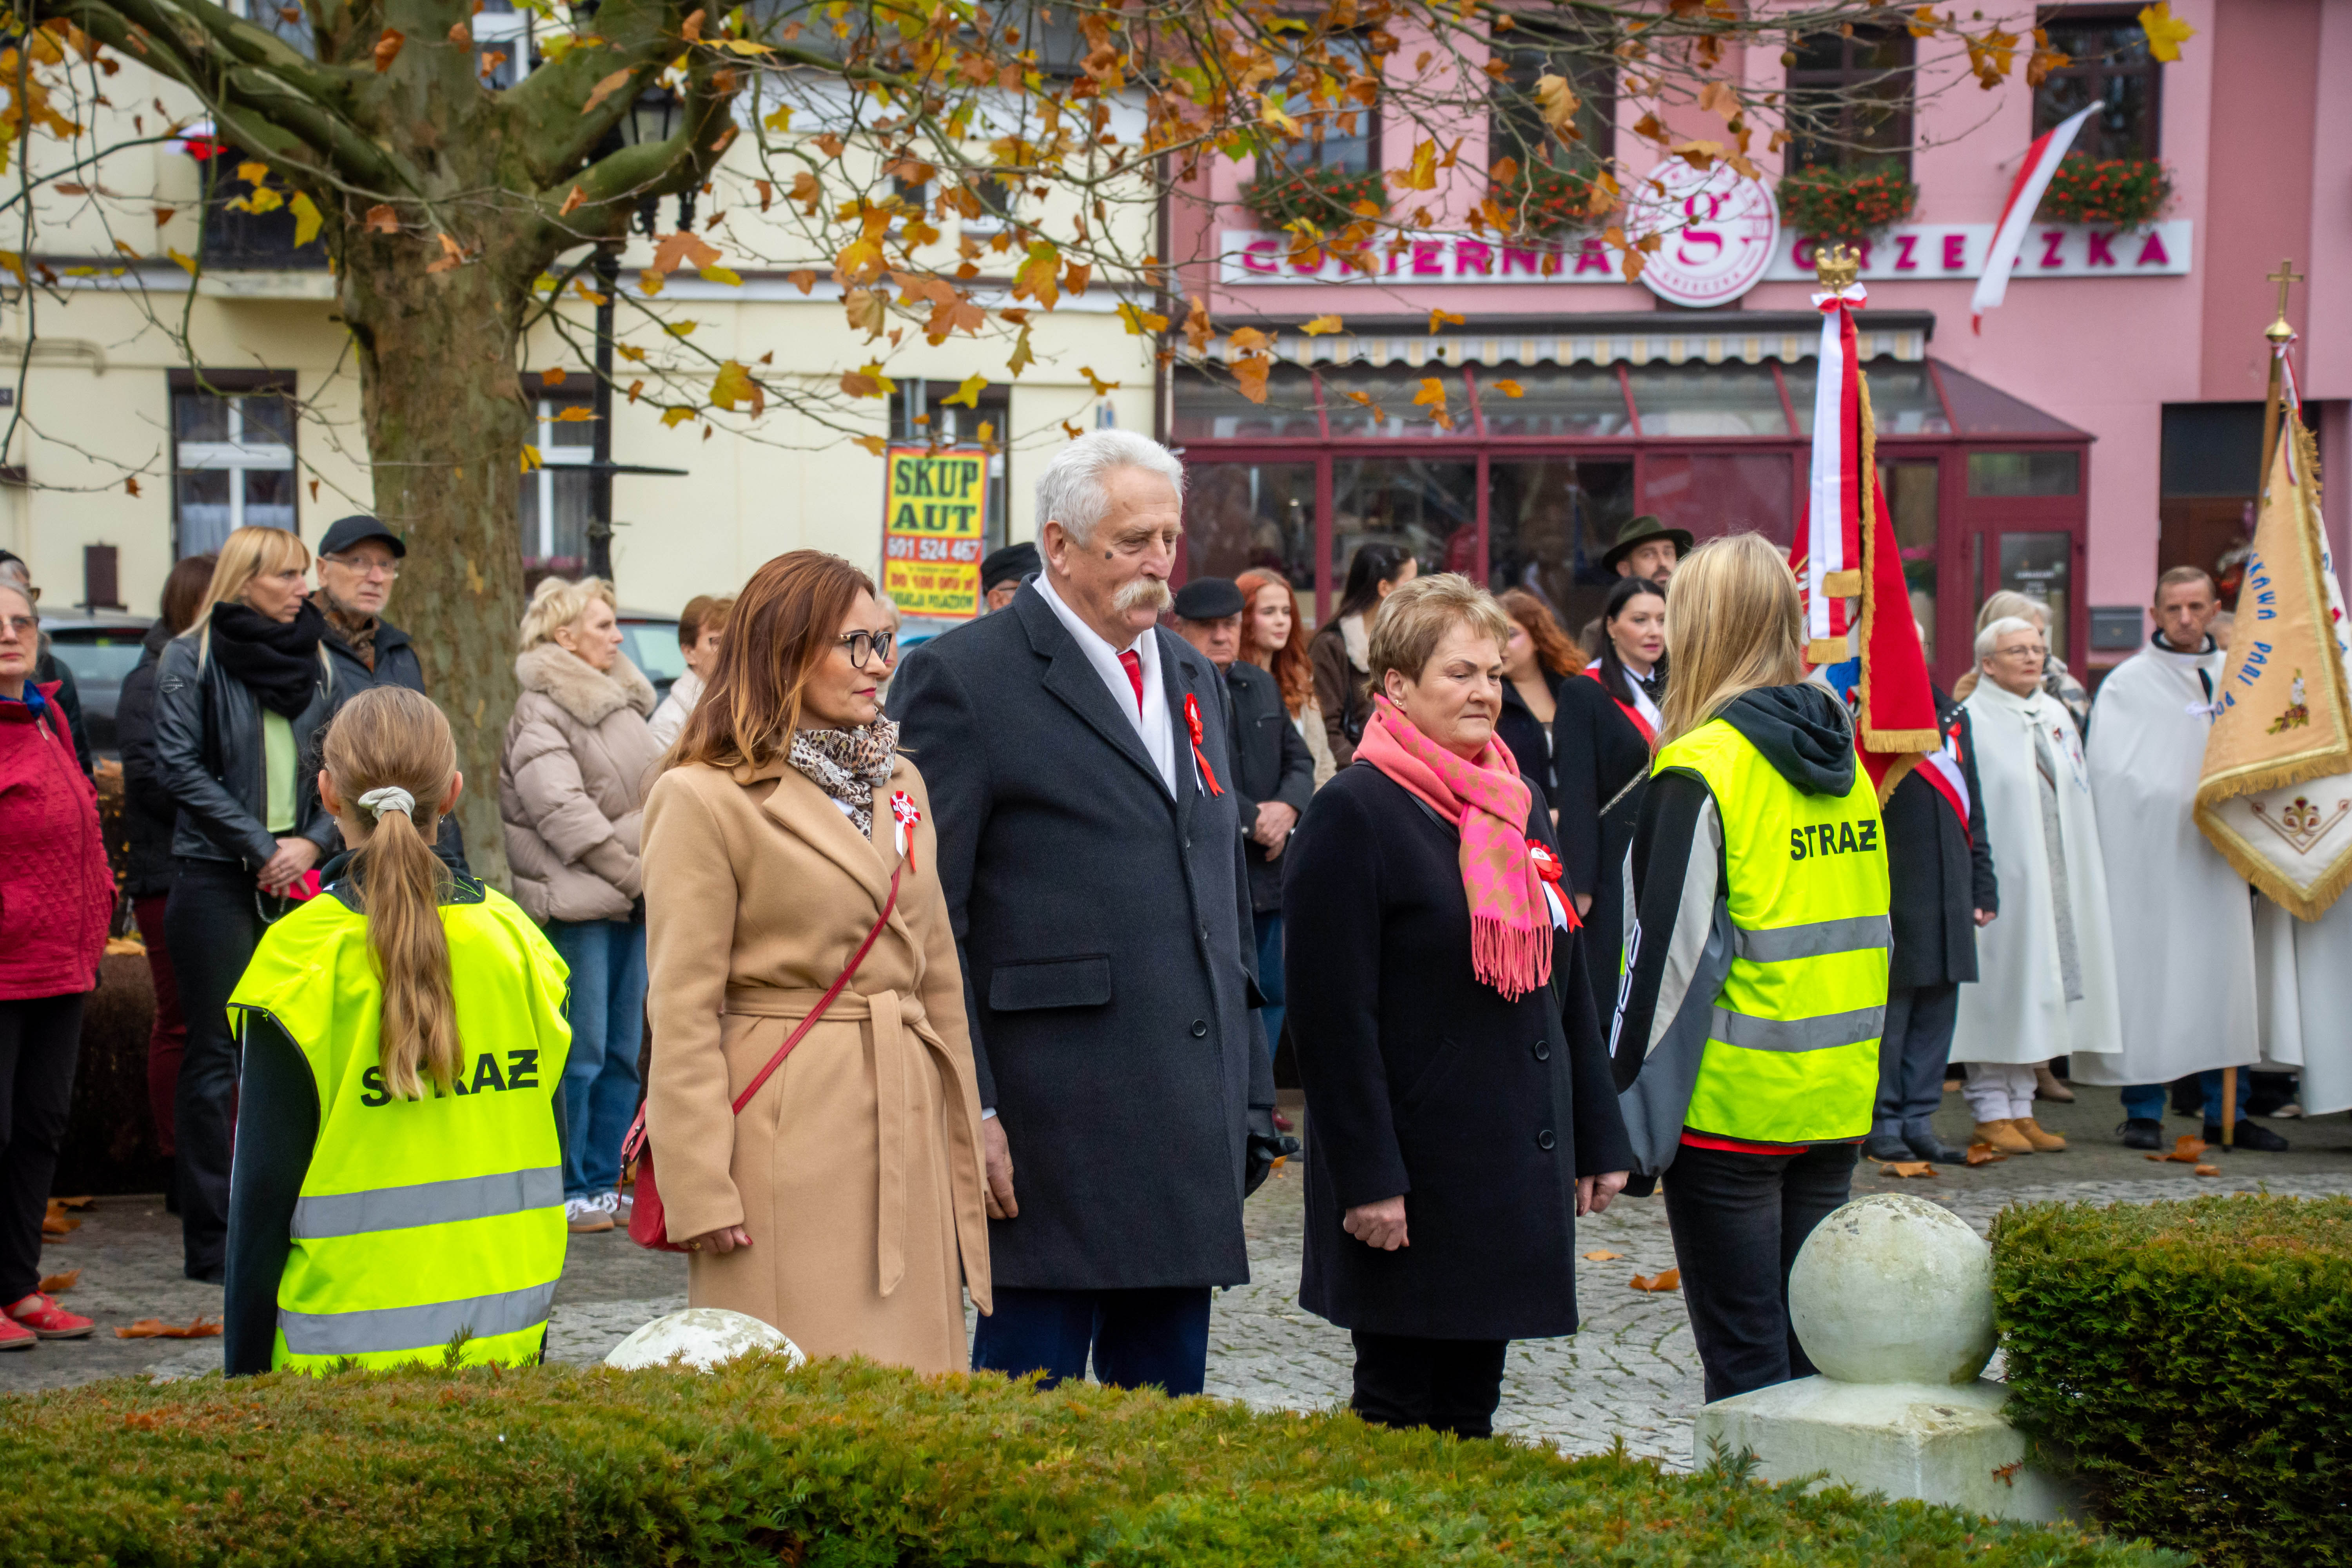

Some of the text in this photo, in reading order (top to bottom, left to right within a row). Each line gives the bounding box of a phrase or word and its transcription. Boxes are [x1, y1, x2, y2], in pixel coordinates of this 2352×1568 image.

[1792, 232, 2170, 270] GRZEZKA
[895, 459, 978, 498] SKUP
[893, 503, 977, 532] AUT
[919, 538, 948, 561] 524
[1790, 819, 1877, 861] STRAŻ
[360, 1049, 539, 1107] SAŻ
